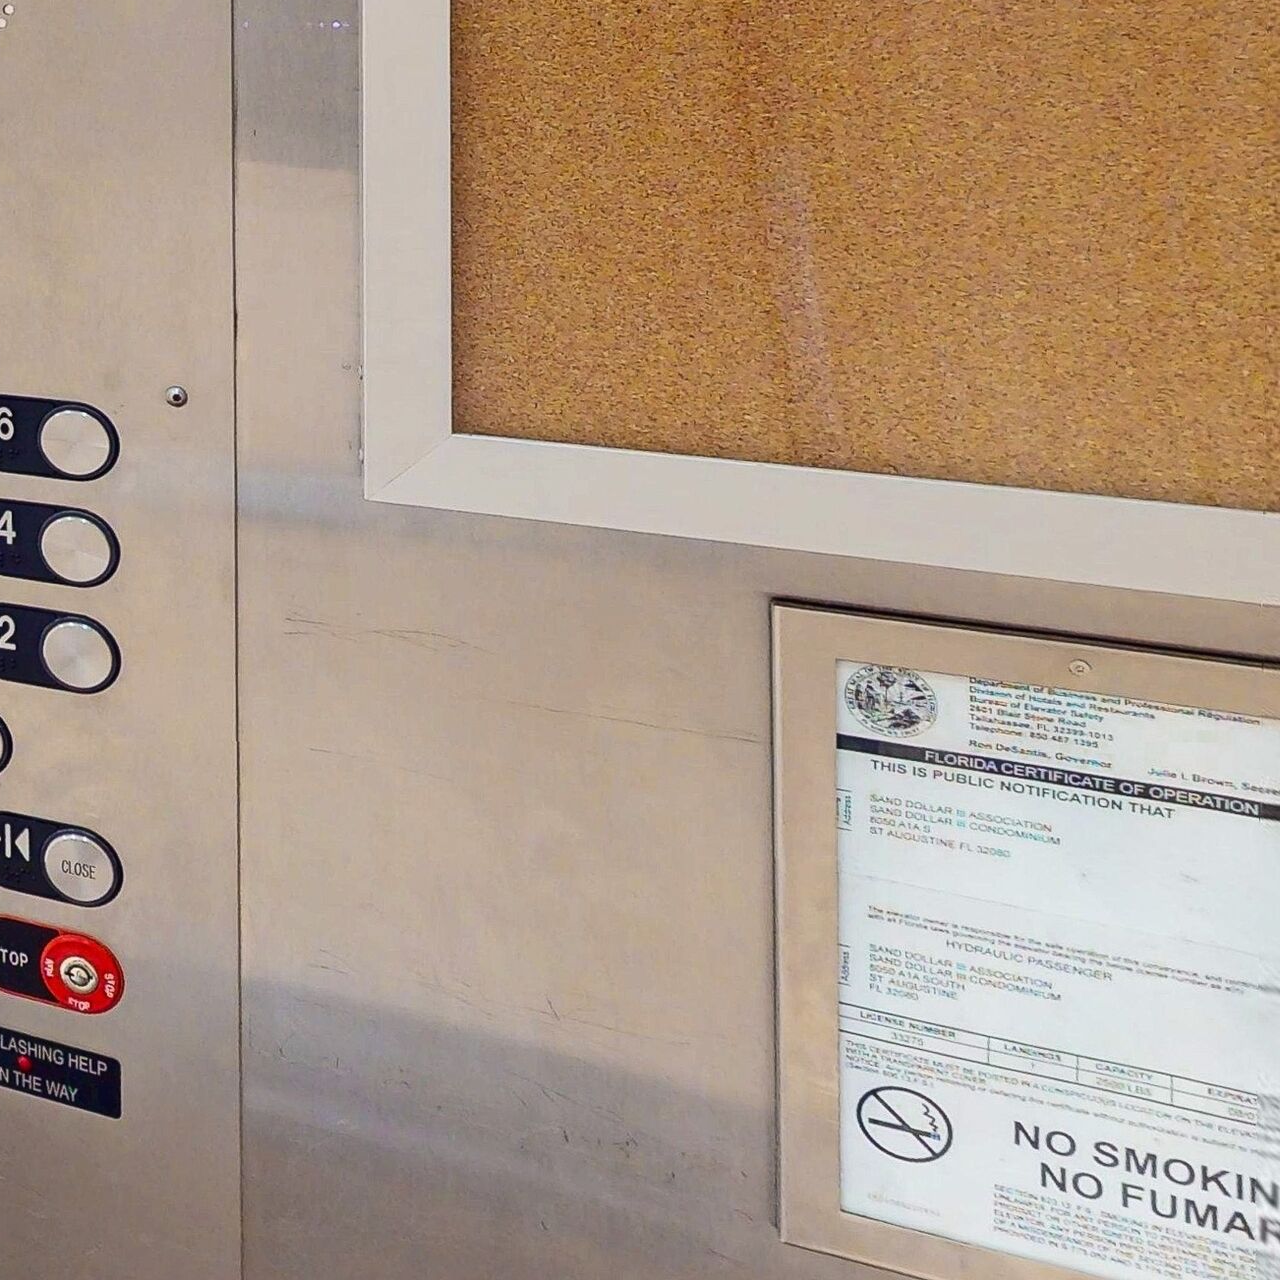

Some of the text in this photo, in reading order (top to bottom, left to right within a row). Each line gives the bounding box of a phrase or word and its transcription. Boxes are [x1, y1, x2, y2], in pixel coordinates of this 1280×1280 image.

[870, 759, 1176, 819] THIS IS PUBLIC NOTIFICATION THAT
[924, 750, 1260, 816] FLORIDA CERTIFICATE OF OPERATION
[870, 794, 903, 807] SAND
[905, 799, 954, 816] DOLLAR
[969, 811, 1053, 833] ASSOCIATION
[870, 804, 903, 818] SAND
[905, 810, 953, 826] DOLLAR
[969, 822, 1061, 846] CONDOMINIUM
[870, 826, 884, 836] ST
[888, 830, 956, 850] AUGUSTINE
[959, 842, 973, 853] FL
[61, 859, 97, 881] CLOSE
[868, 942, 902, 956] SAND
[905, 950, 954, 968] DOLLAR
[969, 965, 1053, 990] ASSOCIATION
[868, 953, 902, 967] SAND
[905, 961, 953, 979] DOLLAR
[969, 975, 1063, 1002] CONDOMINIUM
[946, 940, 1113, 982] HYDRAULIC PASSENGER
[868, 973, 958, 1001] ST AUGUSTINE
[869, 984, 882, 993] FL
[923, 974, 966, 991] SOUTH
[860, 1010, 956, 1039] LICENSE NUMBER
[68, 1052, 108, 1077] HELP
[13, 1069, 42, 1092] THE
[46, 1078, 79, 1103] WAY
[1013, 1121, 1077, 1157] NO
[1040, 1162, 1103, 1200] NO
